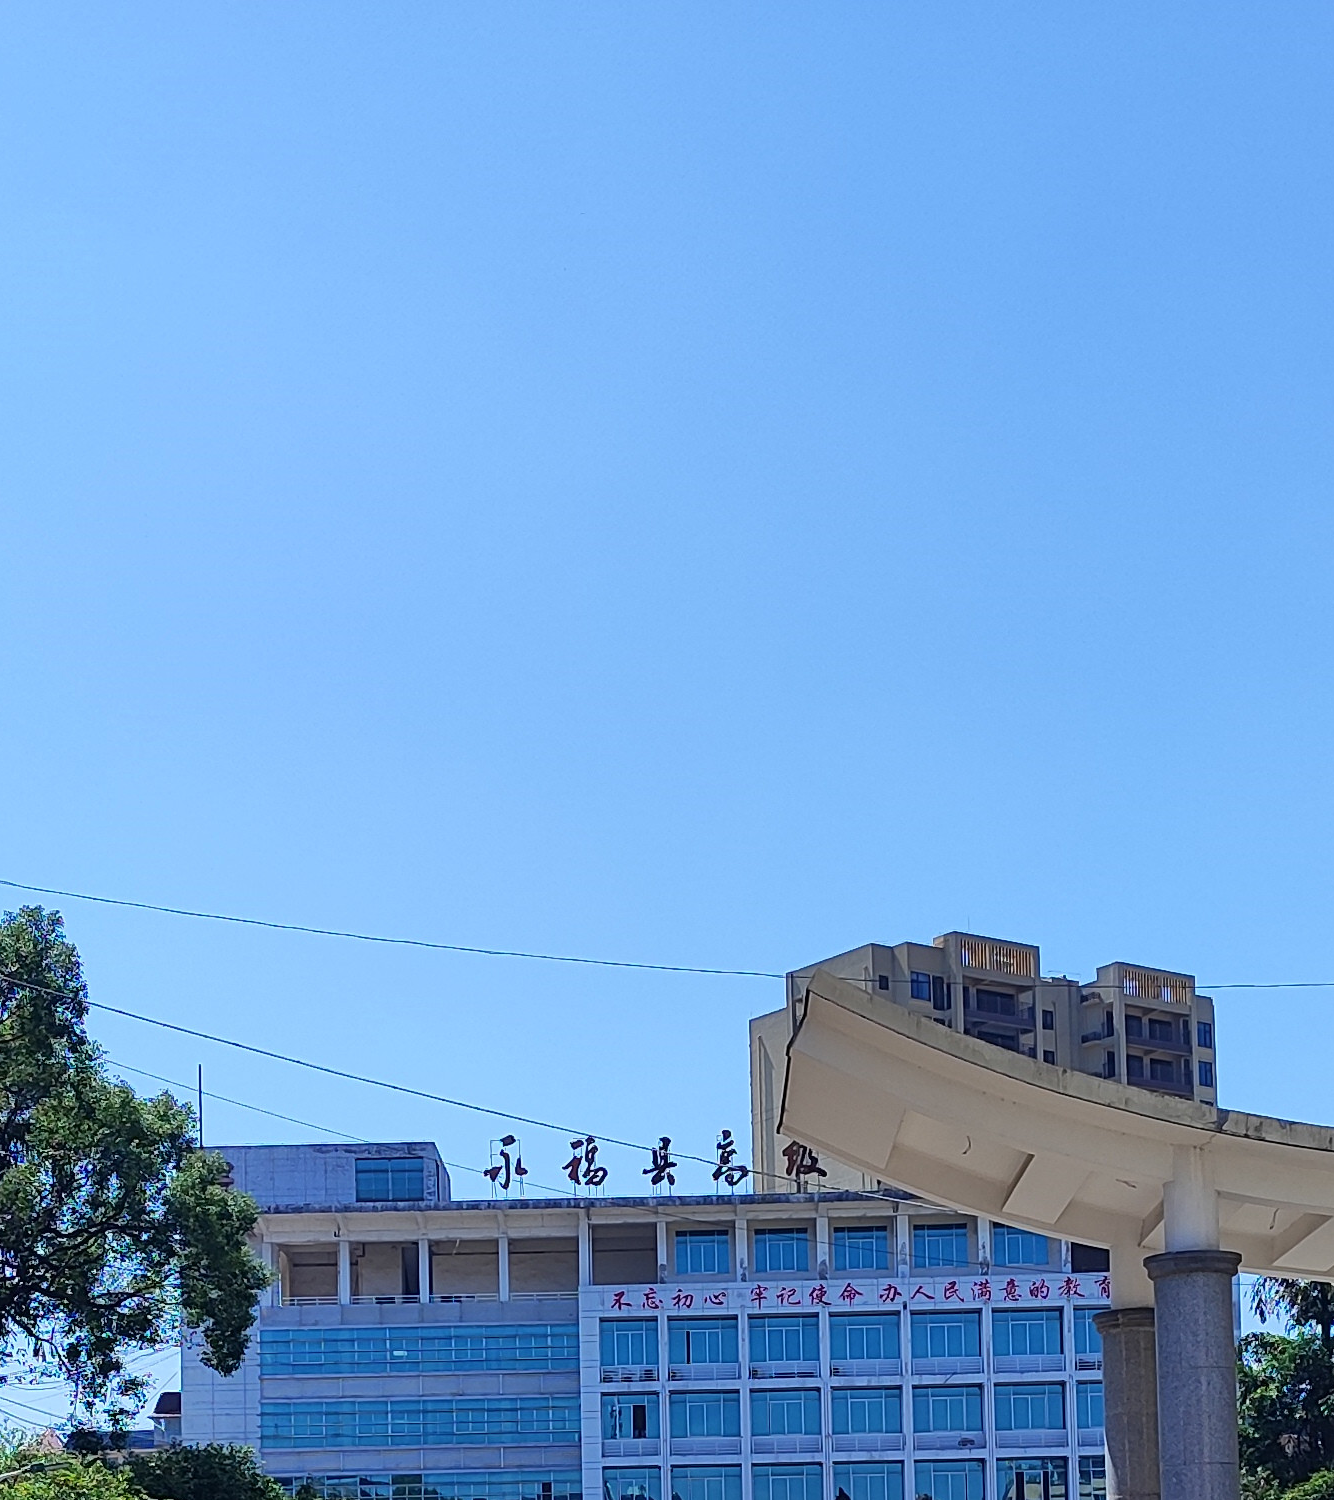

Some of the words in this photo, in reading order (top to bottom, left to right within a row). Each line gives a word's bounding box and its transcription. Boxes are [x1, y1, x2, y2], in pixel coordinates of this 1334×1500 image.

[610, 1287, 727, 1311] 不忘初心
[750, 1282, 863, 1310] 牢记使命
